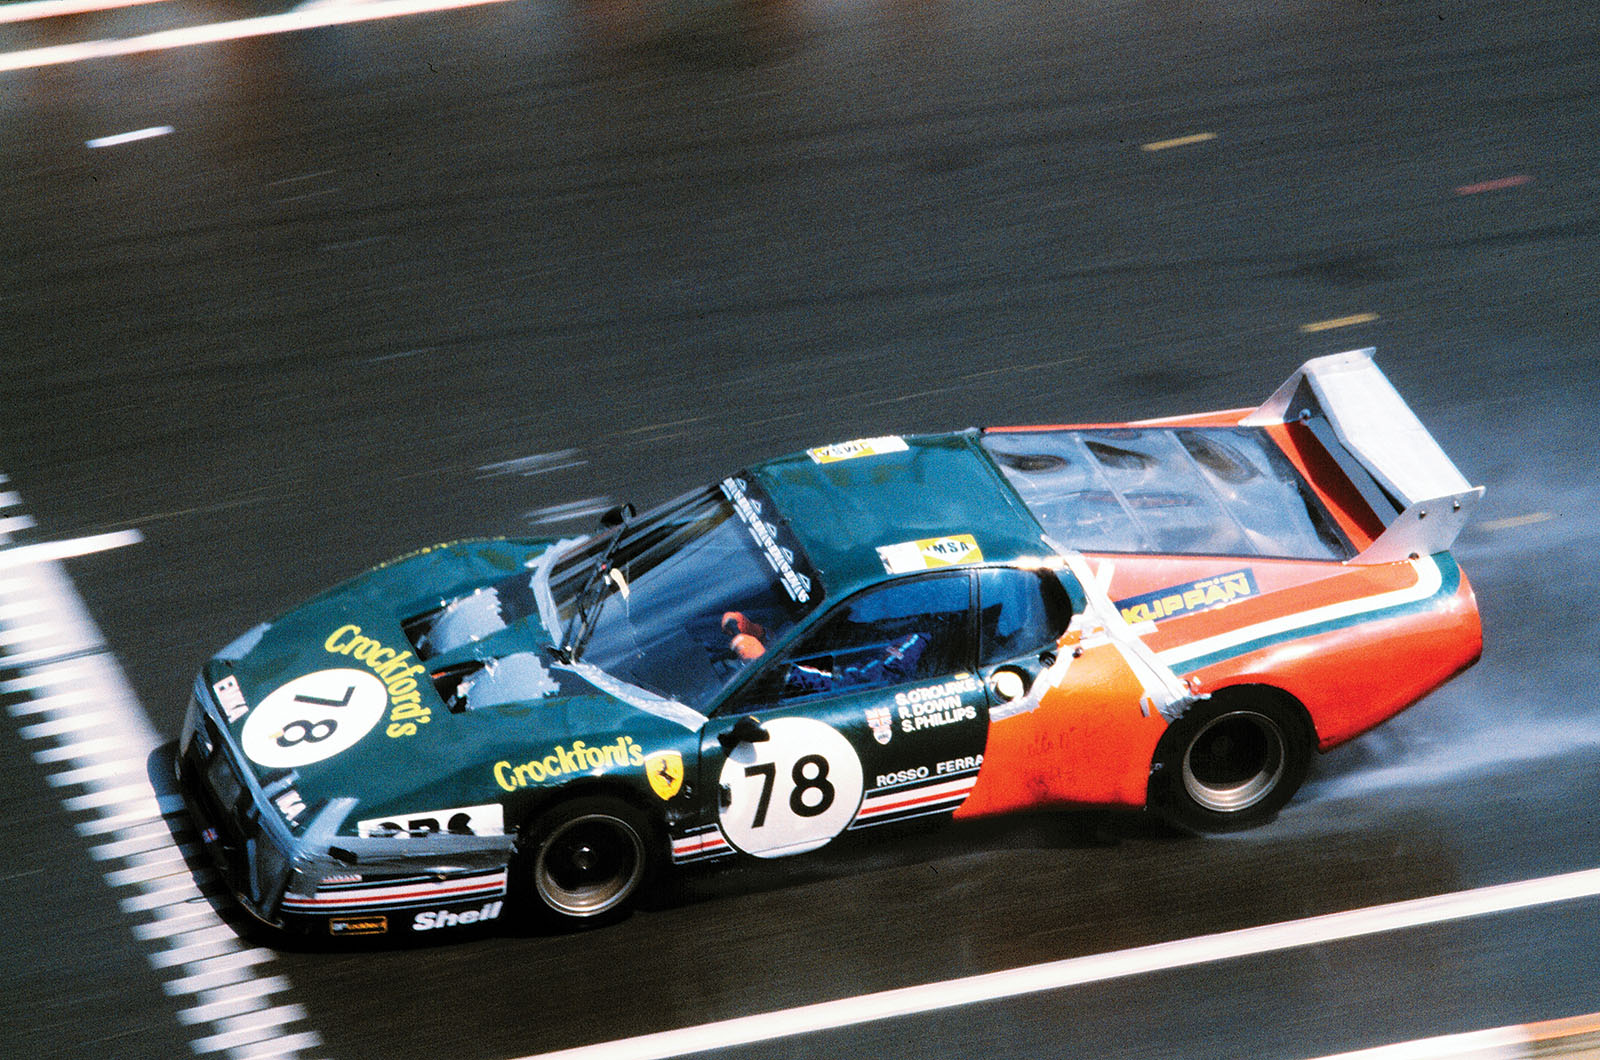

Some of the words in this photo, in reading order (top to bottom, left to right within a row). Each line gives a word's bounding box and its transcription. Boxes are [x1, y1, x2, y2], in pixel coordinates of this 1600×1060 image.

[325, 624, 431, 738] Crockford's
[276, 686, 356, 747] 78
[494, 736, 646, 792] Crockford's
[744, 754, 835, 829] 78
[876, 766, 929, 787] ROSSO
[412, 901, 503, 931] Shell
